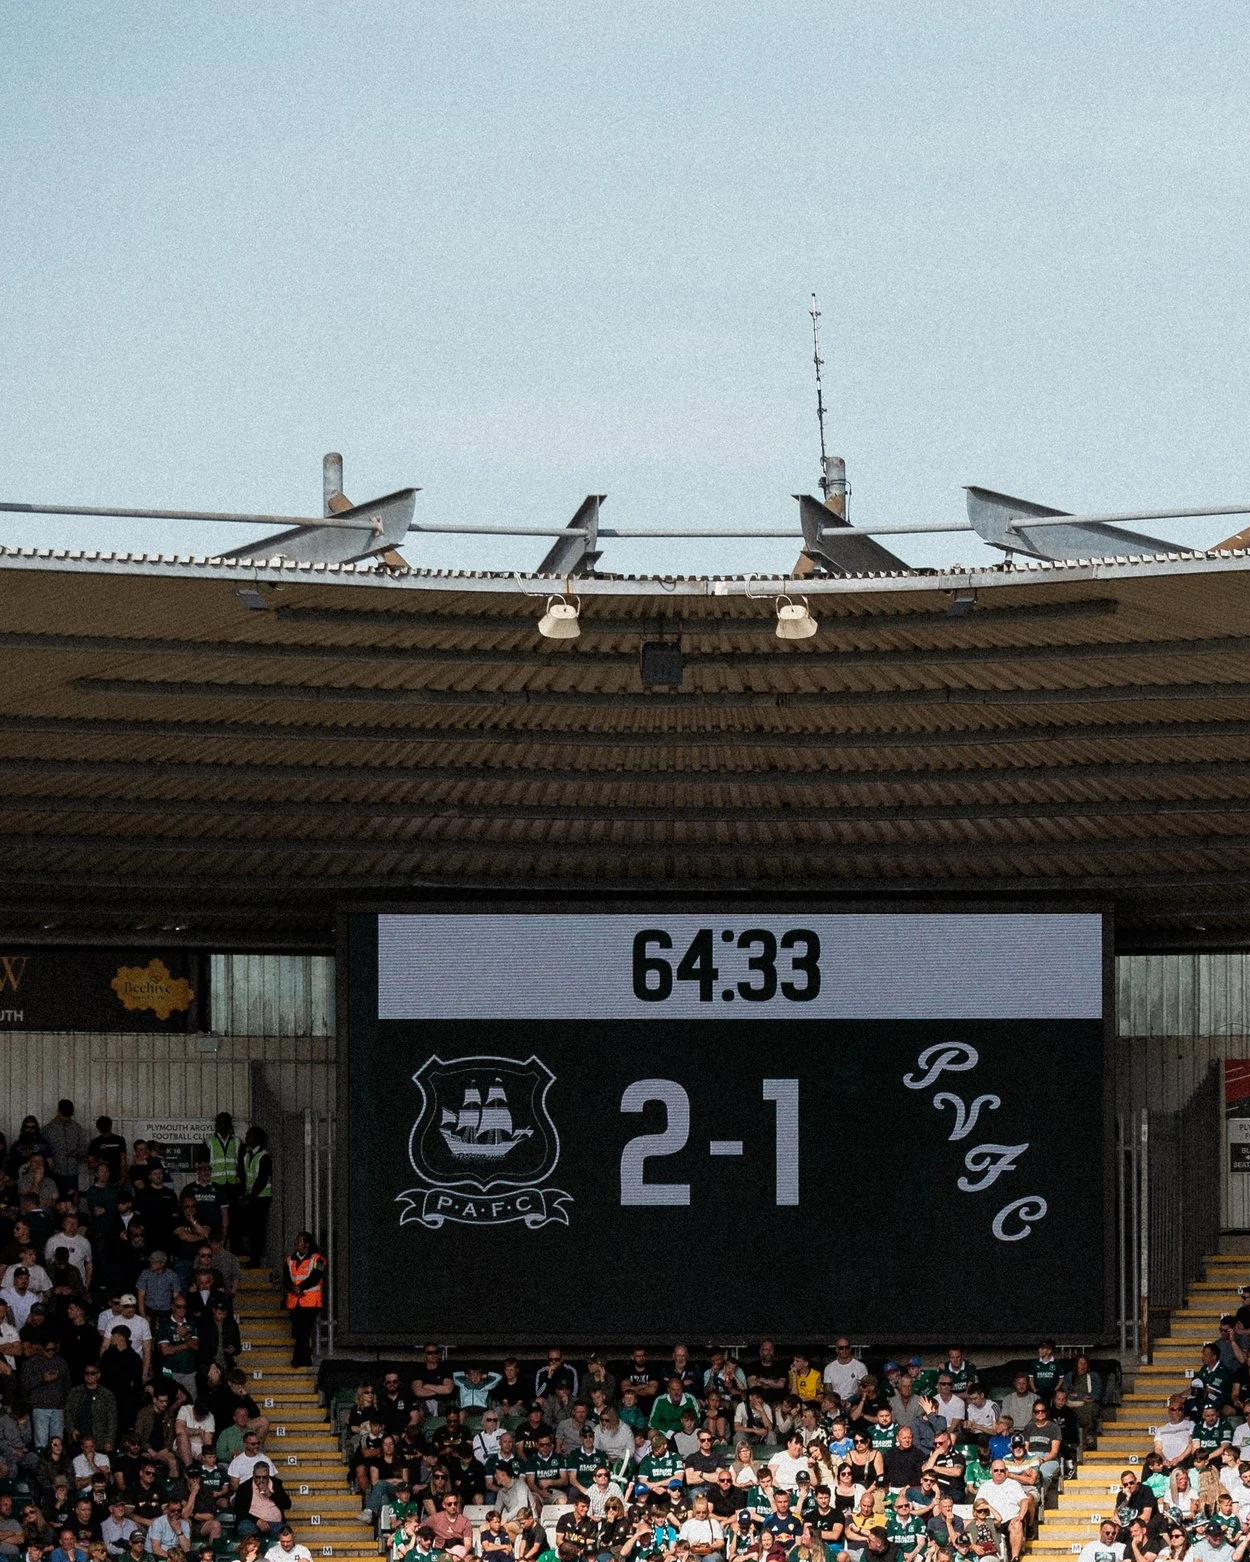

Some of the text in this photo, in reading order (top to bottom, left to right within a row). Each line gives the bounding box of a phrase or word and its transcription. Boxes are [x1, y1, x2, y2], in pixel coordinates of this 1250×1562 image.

[632, 928, 821, 1002] 64:33
[124, 981, 171, 994] Beehive
[147, 1124, 215, 1132] PLYMOUTH ARGYL
